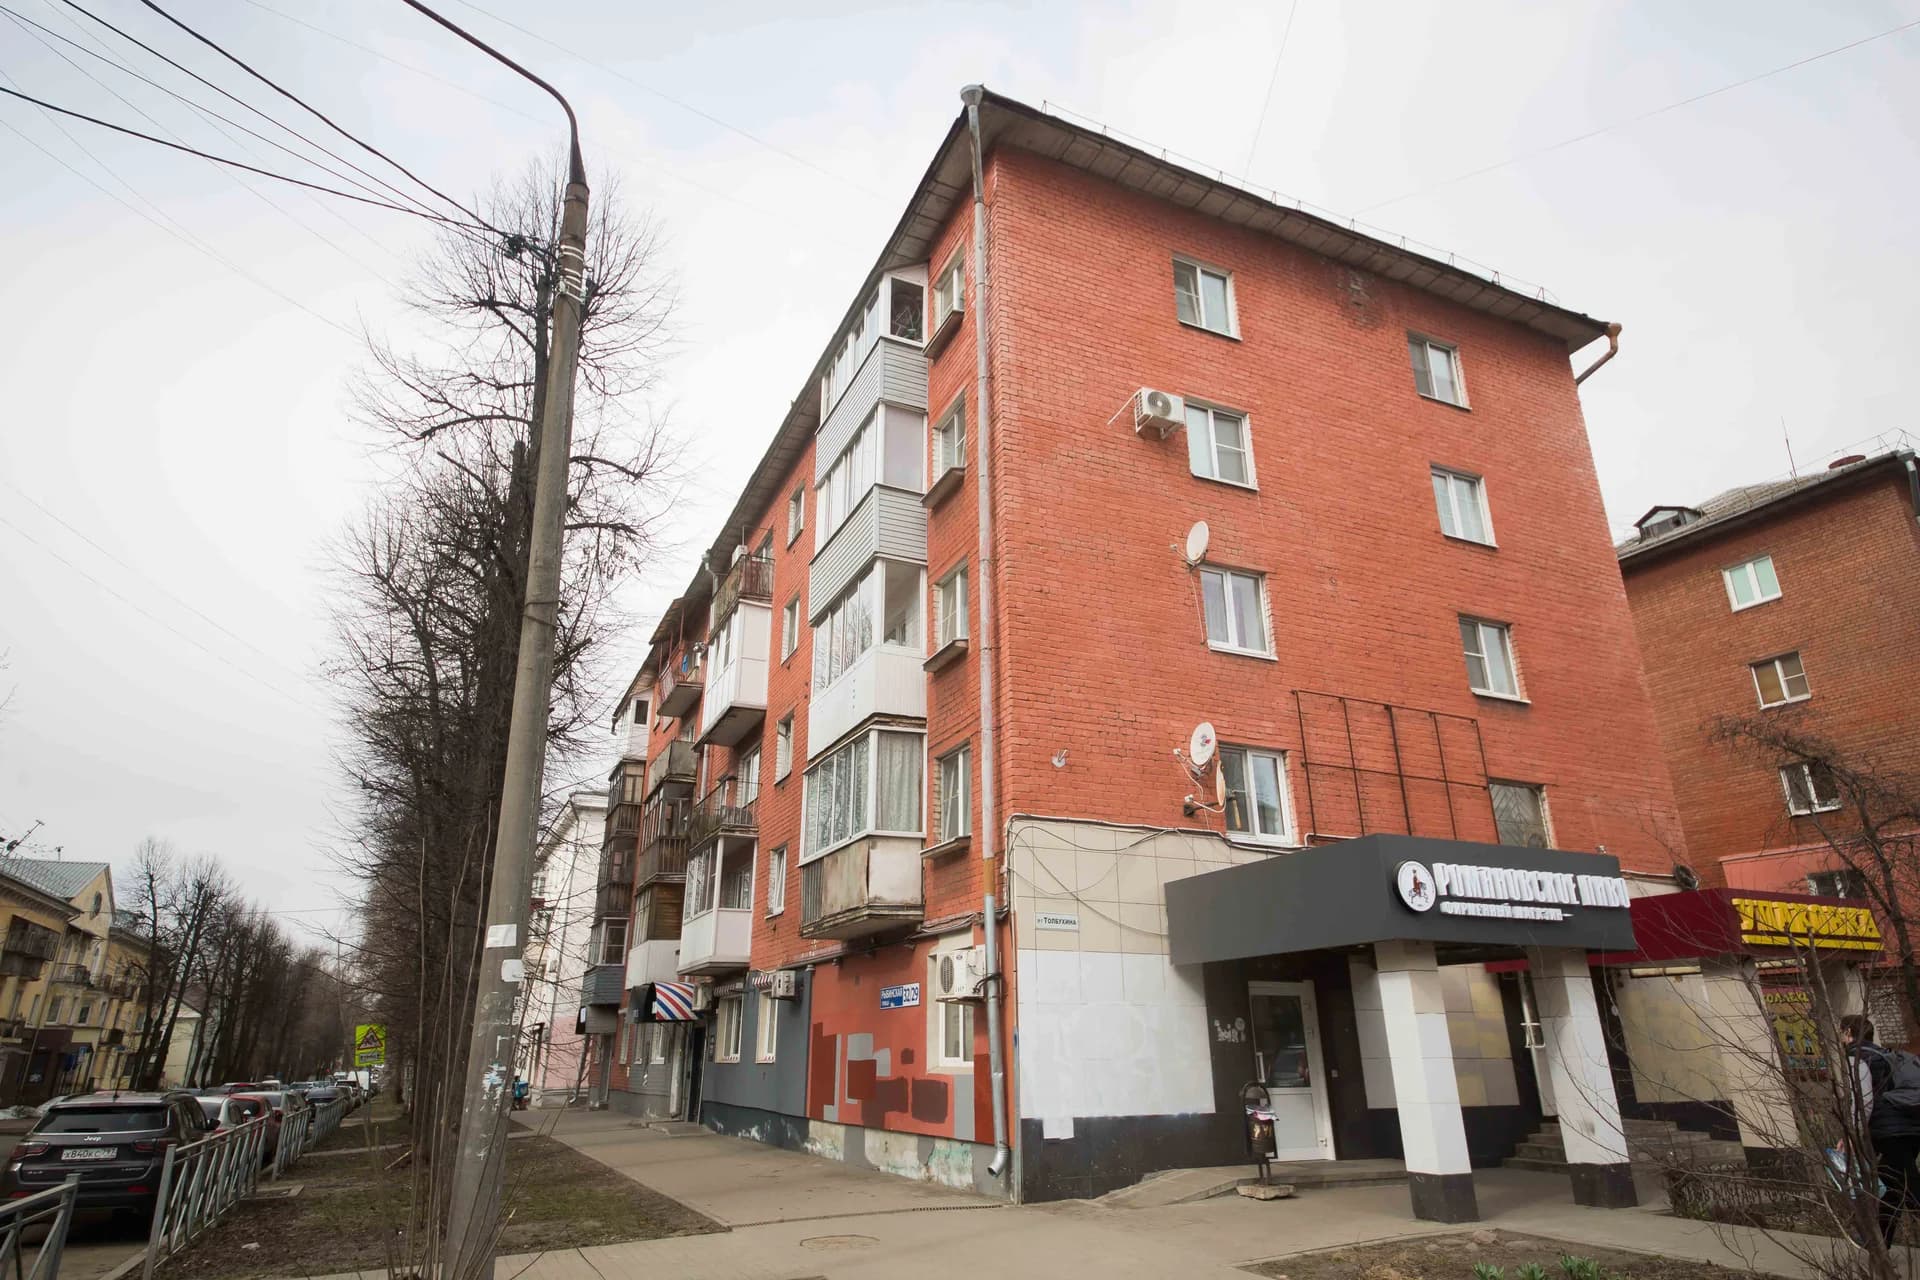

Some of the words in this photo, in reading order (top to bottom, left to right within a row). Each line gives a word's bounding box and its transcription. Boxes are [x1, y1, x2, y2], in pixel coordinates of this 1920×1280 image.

[1432, 863, 1580, 905] РОМАНОВСКОЕ
[1576, 875, 1631, 908] ПИВО
[1732, 897, 1881, 939] УПАКОВКА
